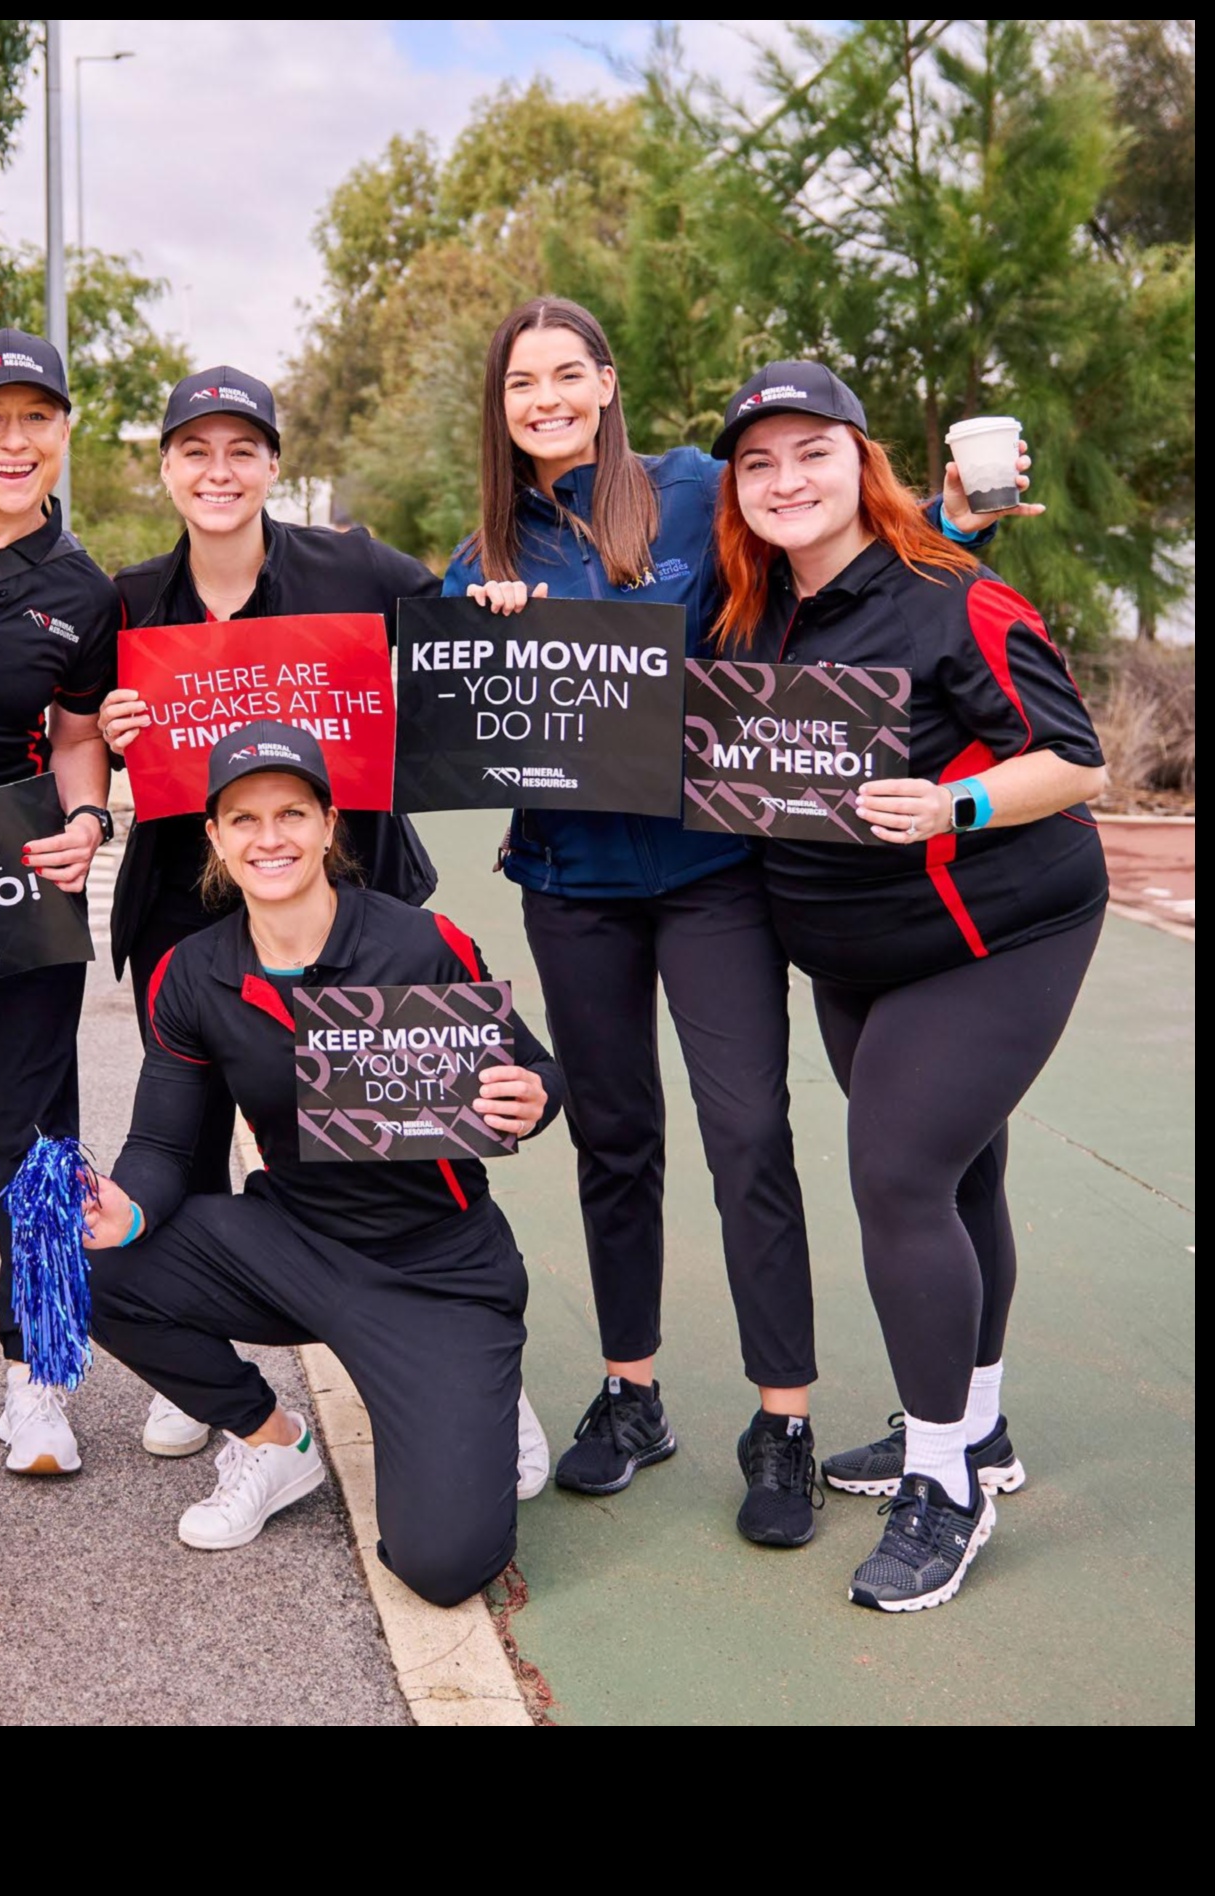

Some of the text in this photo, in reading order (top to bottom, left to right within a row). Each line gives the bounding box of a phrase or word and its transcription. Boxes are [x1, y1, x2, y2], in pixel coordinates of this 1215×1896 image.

[761, 385, 796, 398] MINERAL
[658, 563, 688, 576] strides
[412, 640, 668, 677] KEEP MOVING
[175, 663, 329, 696] THERE ARE
[549, 677, 628, 709] CAN
[146, 691, 383, 726] UPCAKES AT THE
[477, 711, 584, 742] DO IT!
[736, 715, 848, 746] YOU'RE
[257, 743, 292, 753] MINERAL
[259, 749, 301, 762] RESOURCES
[712, 744, 872, 778] MY HERO!
[522, 767, 565, 778] MINERAL
[522, 778, 578, 788] RESOURCES
[786, 799, 818, 809] MINERAL
[786, 806, 828, 816] RESOURCES
[308, 1023, 500, 1051] KEEP MOVING
[417, 1052, 475, 1075] CAN
[365, 1079, 445, 1102] DO IT!
[403, 1120, 433, 1128] MINERAL
[403, 1127, 444, 1136] RESOURCES
